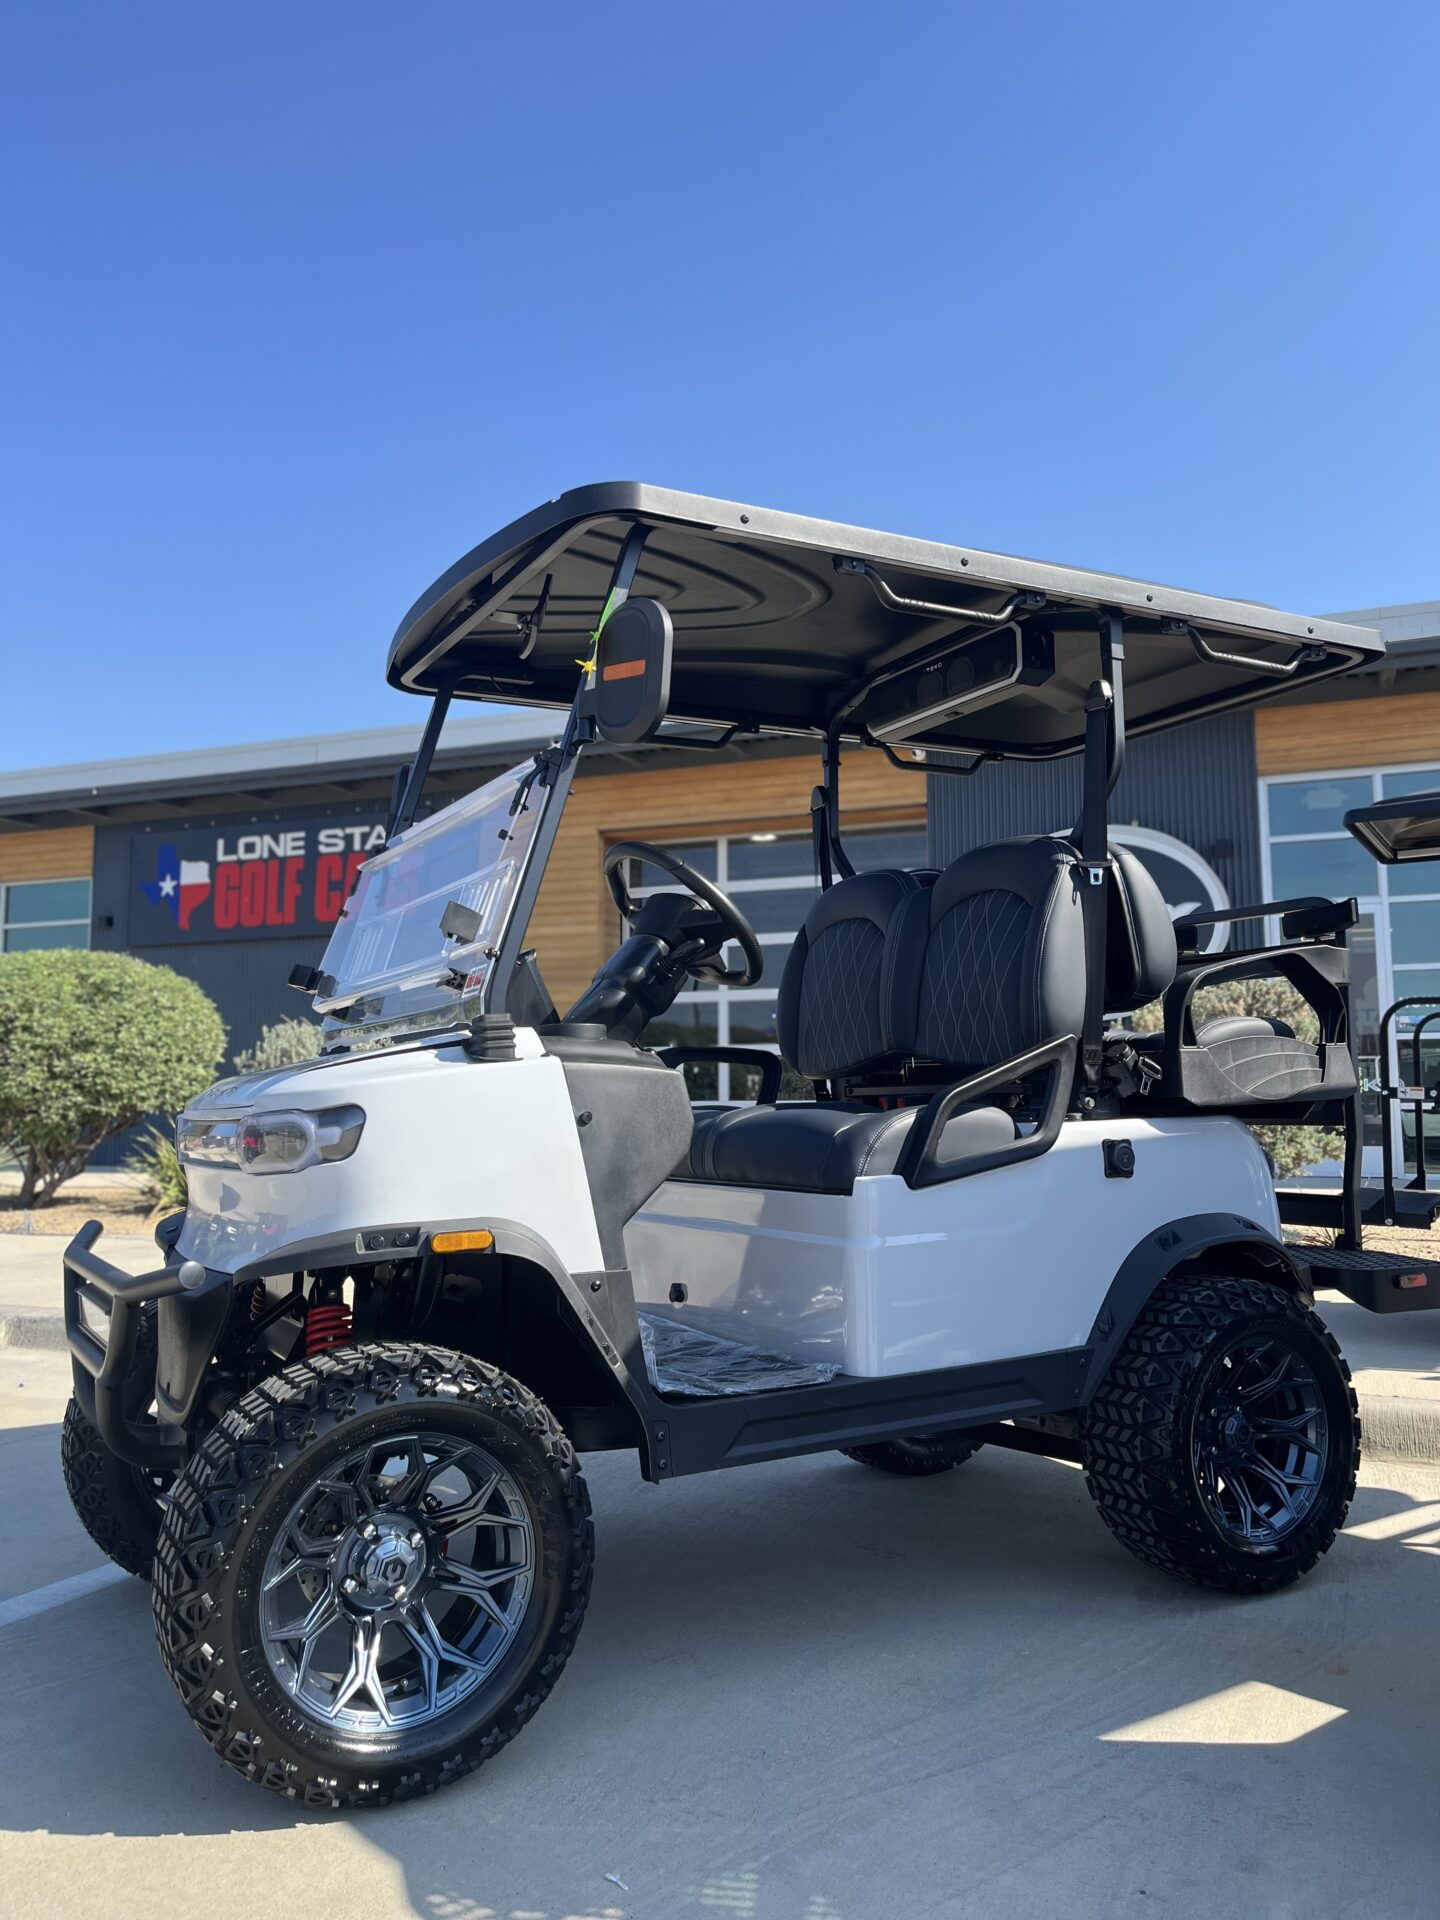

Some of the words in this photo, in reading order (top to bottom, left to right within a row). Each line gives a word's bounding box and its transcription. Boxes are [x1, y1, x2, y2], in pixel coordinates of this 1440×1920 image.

[216, 831, 306, 862] LONE
[318, 824, 387, 854] STA
[213, 854, 304, 929] GOLF
